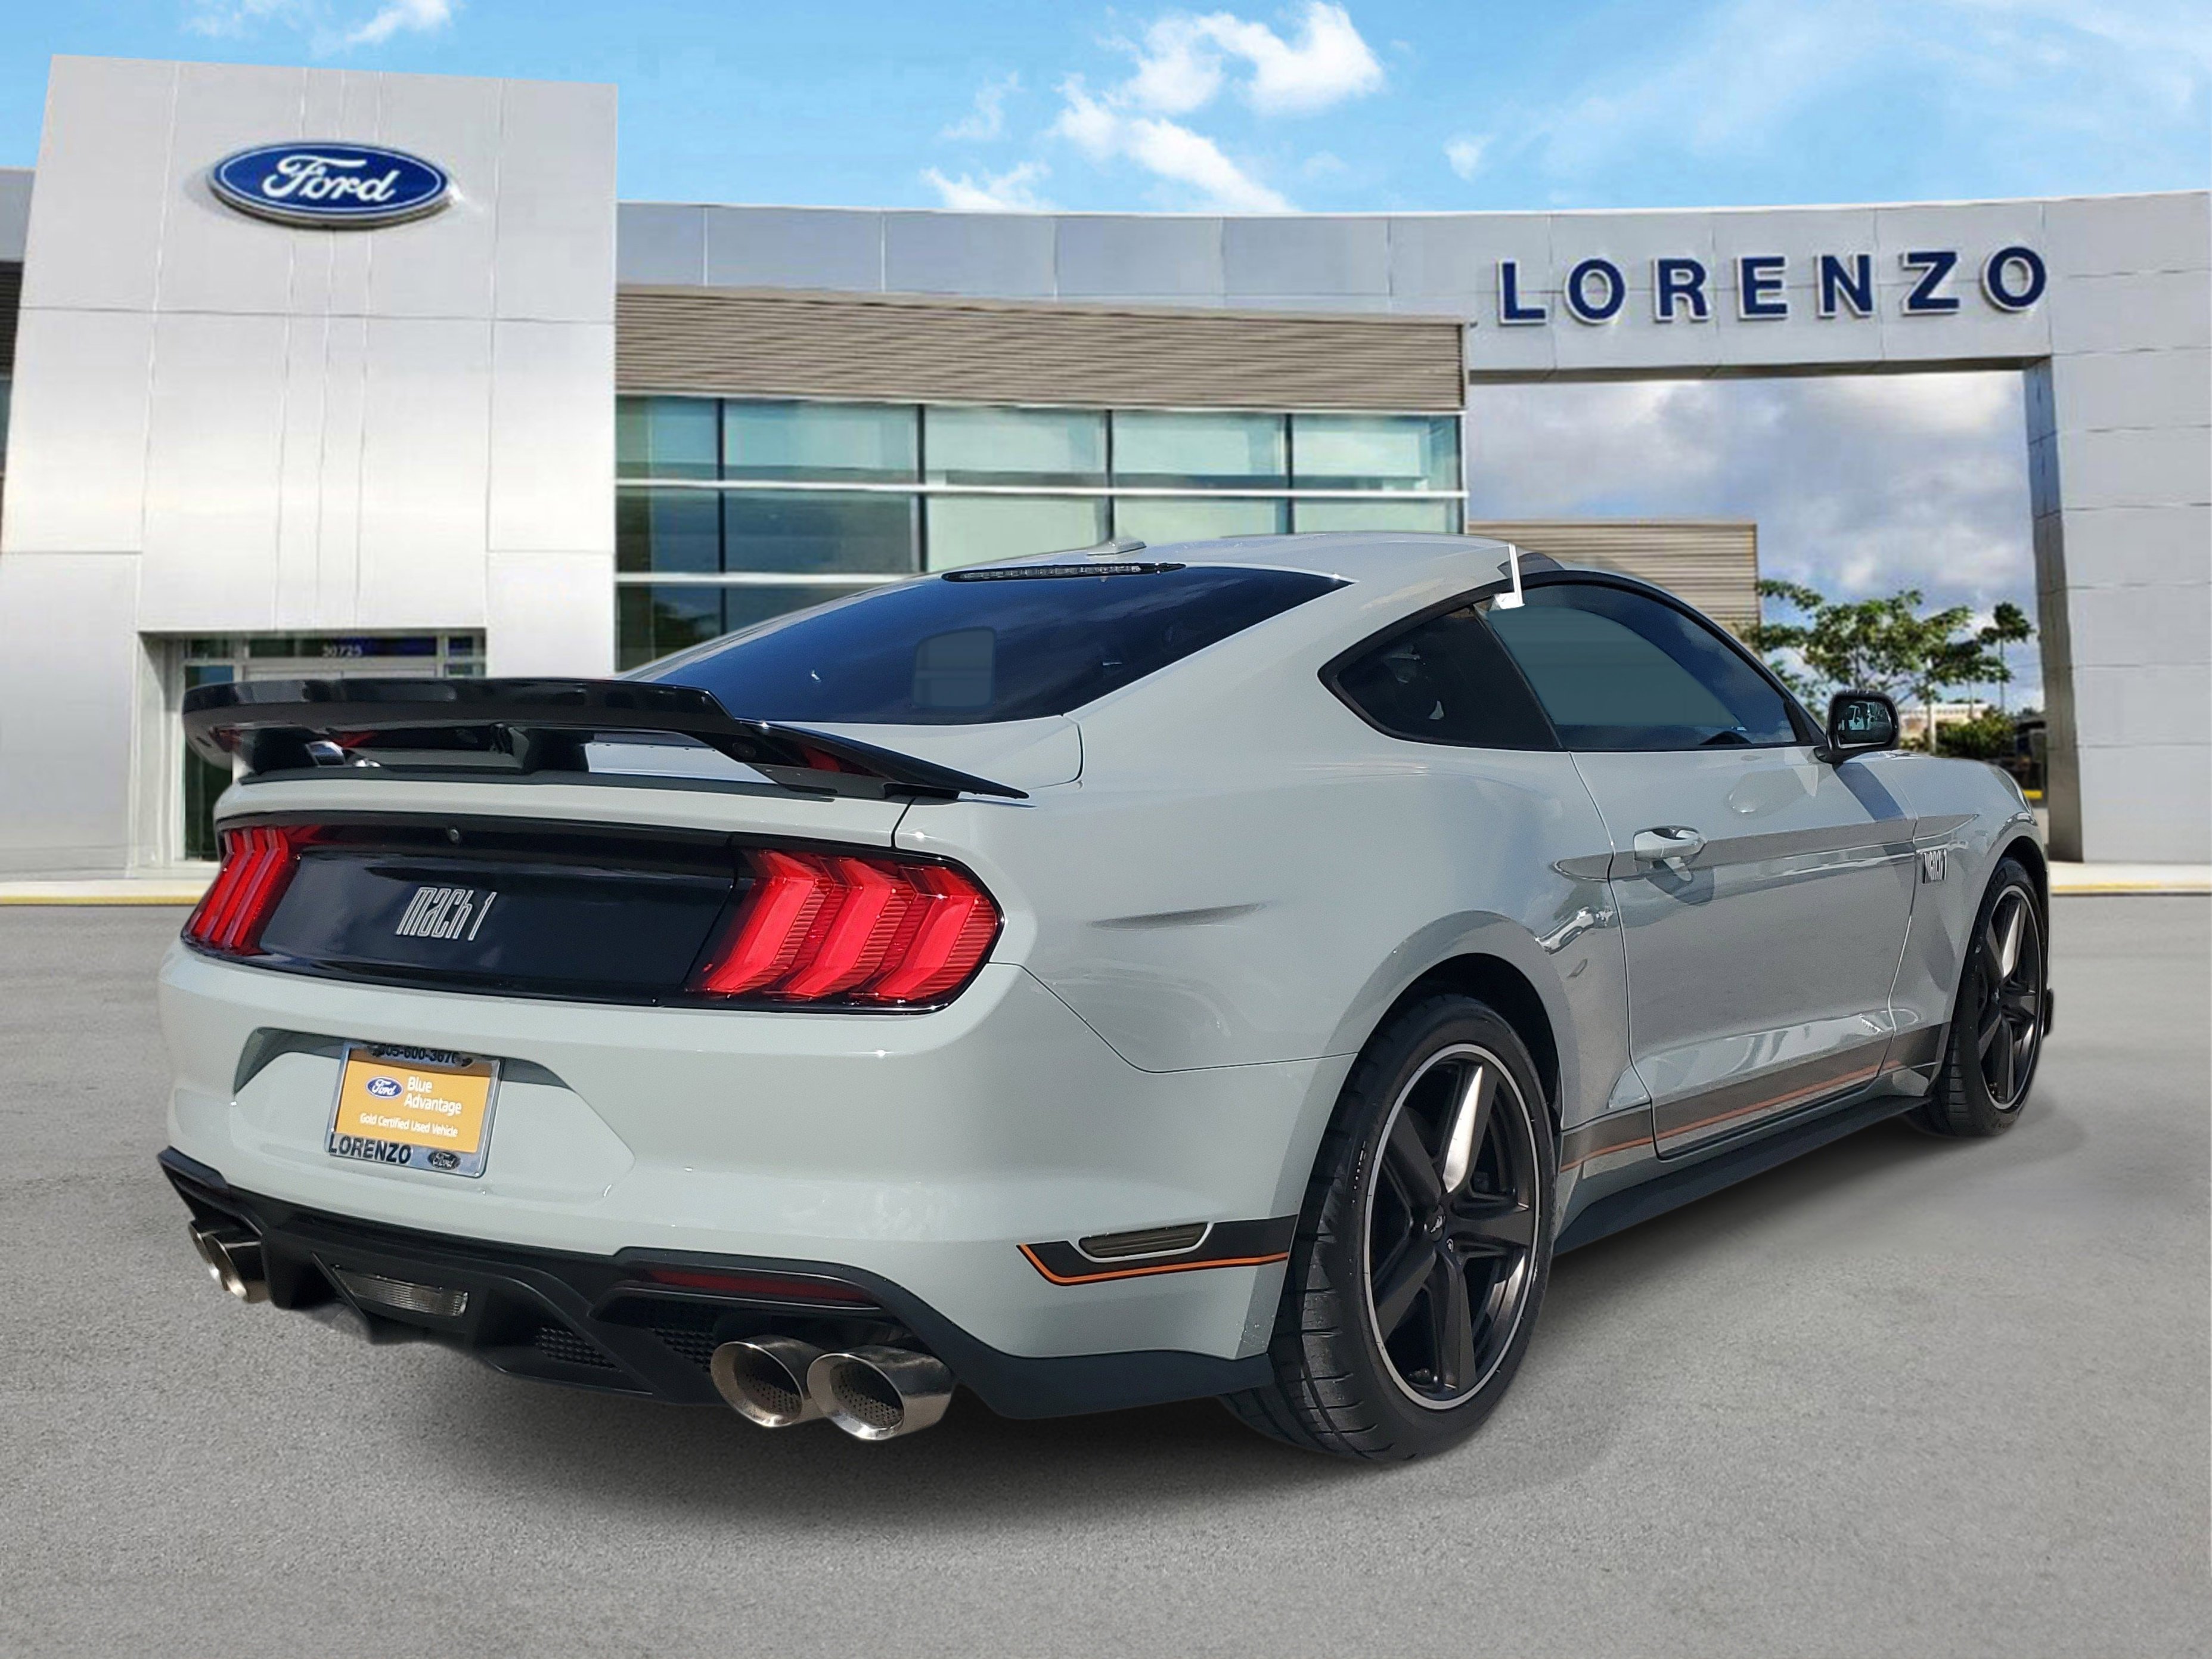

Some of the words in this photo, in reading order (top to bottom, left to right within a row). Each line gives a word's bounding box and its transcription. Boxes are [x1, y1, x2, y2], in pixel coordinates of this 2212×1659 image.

[262, 154, 400, 202] Ford
[1499, 246, 2047, 325] LORENZO
[467, 891, 498, 941] 1
[371, 1078, 397, 1096] Ford
[407, 1075, 433, 1093] Blue
[404, 1092, 463, 1117] Advantage
[359, 1112, 377, 1125] Gold
[377, 1115, 409, 1130] Certified
[411, 1120, 430, 1133] Used
[432, 1123, 458, 1138] Vehicle
[328, 1133, 412, 1164] LORENZO
